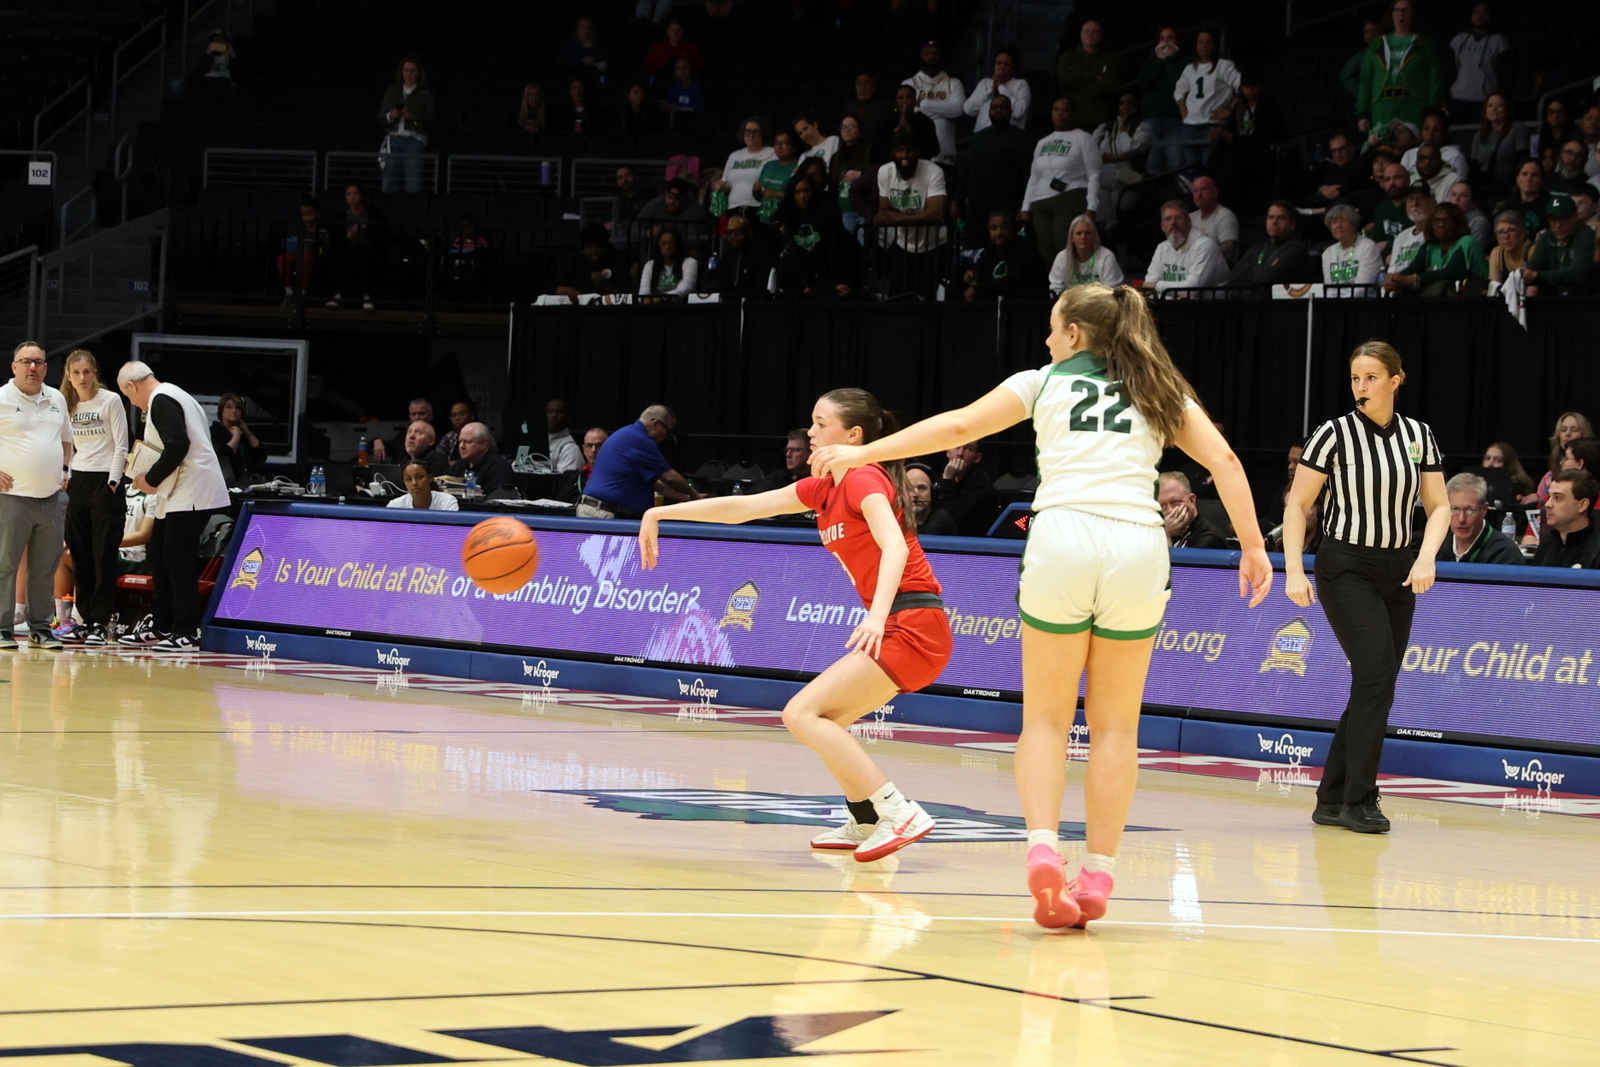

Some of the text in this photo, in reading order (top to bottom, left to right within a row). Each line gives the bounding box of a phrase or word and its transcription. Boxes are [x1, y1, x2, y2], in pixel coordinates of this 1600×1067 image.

[1196, 77, 1204, 98] 1
[31, 168, 48, 178] 102
[1551, 199, 1561, 207] L
[133, 281, 150, 291] 102
[1069, 379, 1133, 434] 22
[73, 428, 106, 437] ASKETBALL
[274, 557, 292, 583] Is
[295, 559, 337, 587] Your
[337, 562, 389, 592] Child
[385, 566, 408, 592] at
[406, 567, 449, 596] Risk
[593, 580, 701, 615] Disorder?
[785, 596, 846, 625] Learn
[254, 635, 277, 657] Kroger
[1154, 622, 1227, 662] io.org
[386, 647, 411, 672] Kroger
[614, 656, 645, 664] DAKTRONICS
[1400, 644, 1460, 674] our
[1463, 641, 1553, 682] Child
[1555, 649, 1593, 685] at
[533, 660, 560, 686] Kroger
[690, 678, 719, 705] Kroger
[963, 688, 1001, 698] DAKTRONICS
[1396, 728, 1443, 739] DAKTRONICS
[1274, 733, 1313, 766] Kroger
[1521, 758, 1565, 791] Kroger
